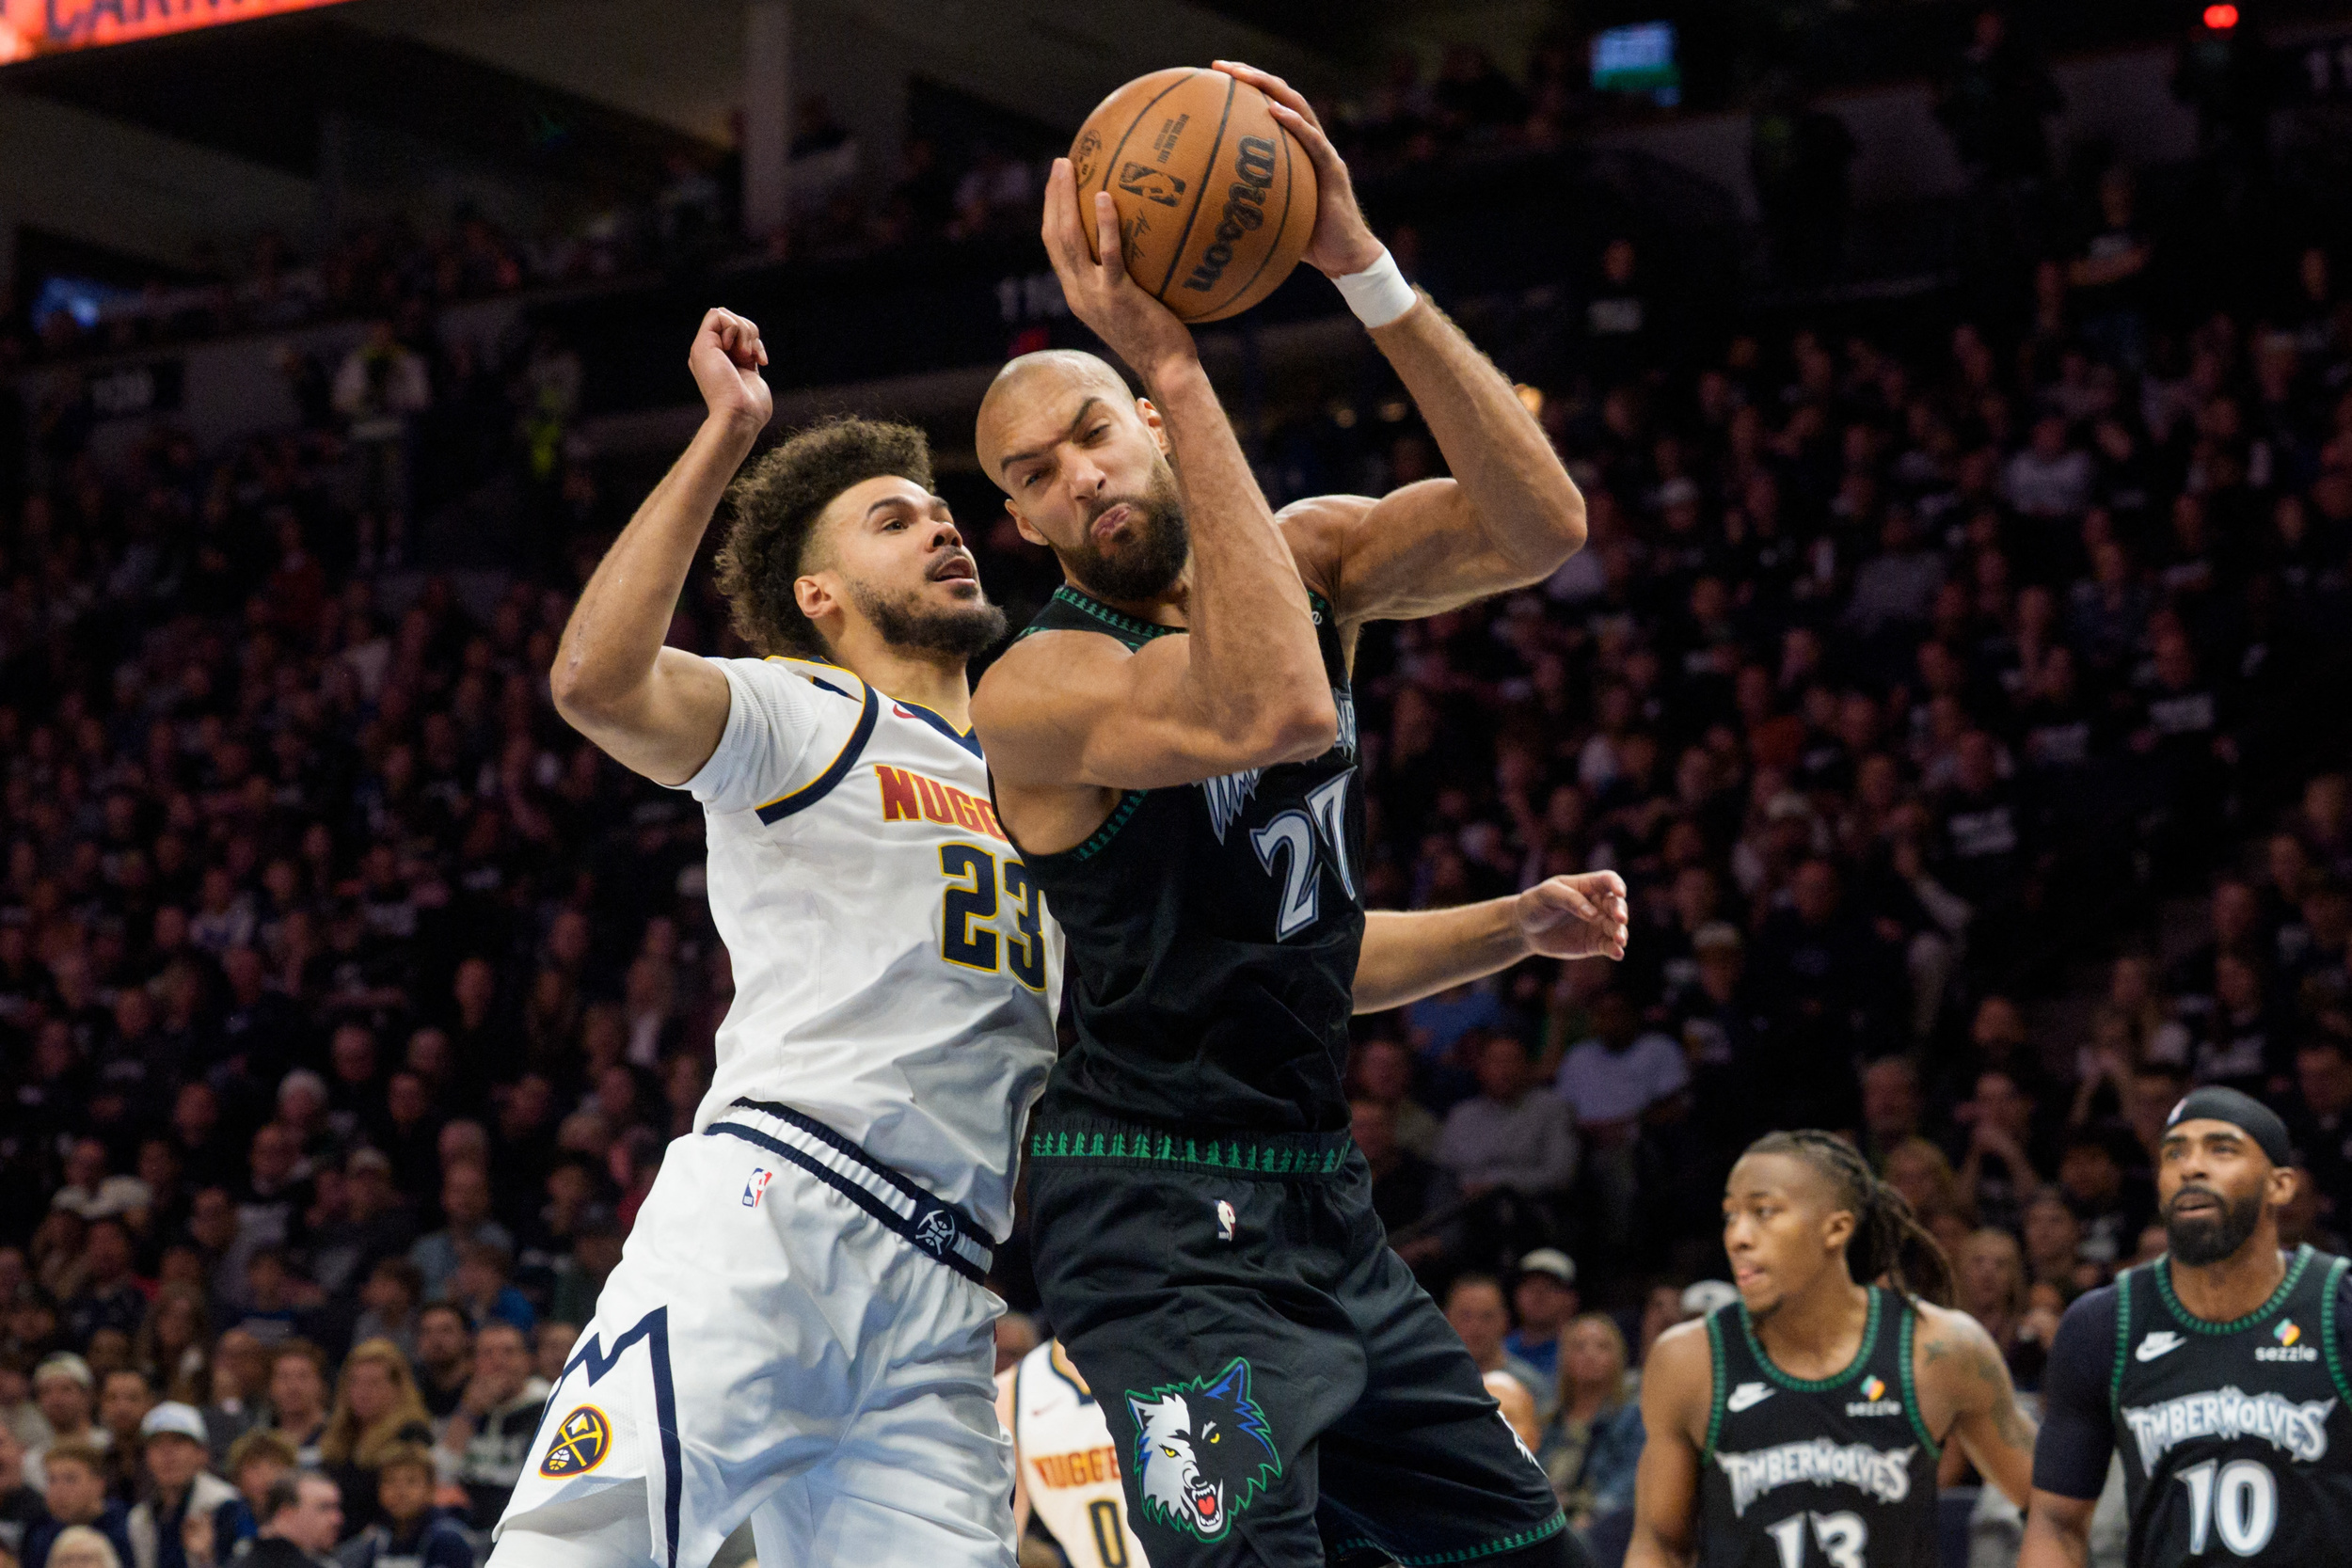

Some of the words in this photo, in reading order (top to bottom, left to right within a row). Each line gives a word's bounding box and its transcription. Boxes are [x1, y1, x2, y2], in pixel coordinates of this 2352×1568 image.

[1182, 135, 1277, 293] Wilson
[1249, 765, 1359, 942] 27
[938, 842, 1046, 991] 23
[2254, 1344, 2319, 1362] sezzle
[1713, 1436, 1919, 1518] TIMBERWOLVES
[2121, 1385, 2339, 1480] TIMBERWOLVES
[1086, 1497, 1130, 1568] 0
[1765, 1510, 1868, 1568] 13
[2173, 1458, 2279, 1557] 10
